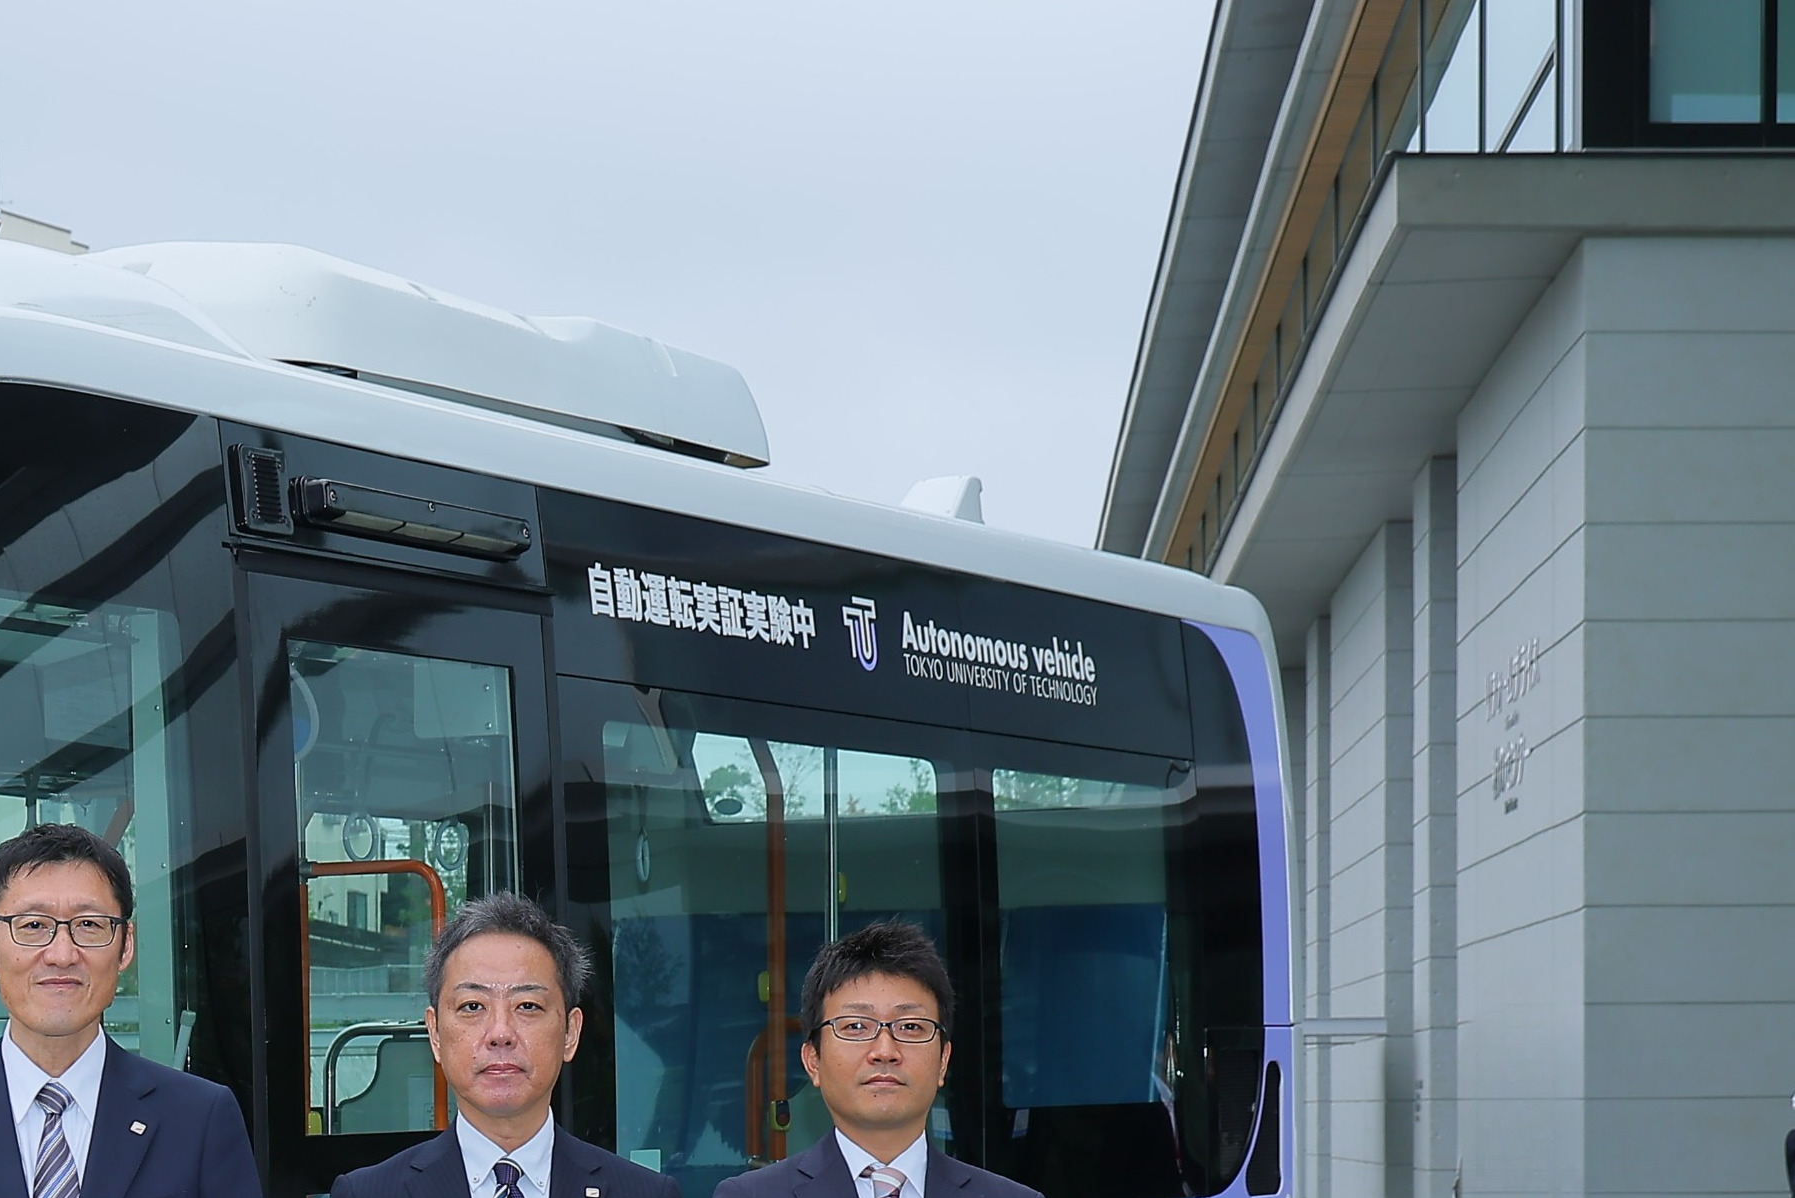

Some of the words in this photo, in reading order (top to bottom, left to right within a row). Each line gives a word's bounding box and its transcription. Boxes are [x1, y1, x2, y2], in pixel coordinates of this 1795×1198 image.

[587, 562, 816, 649] 自動運転実証実験中
[902, 611, 1029, 671] Autonomous
[1032, 637, 1096, 683] vehicle
[903, 653, 943, 681] TOKYO
[946, 661, 1010, 692] UNIVERSITY
[1013, 672, 1027, 695] OF
[1029, 675, 1097, 706] TECHNOLOGY
